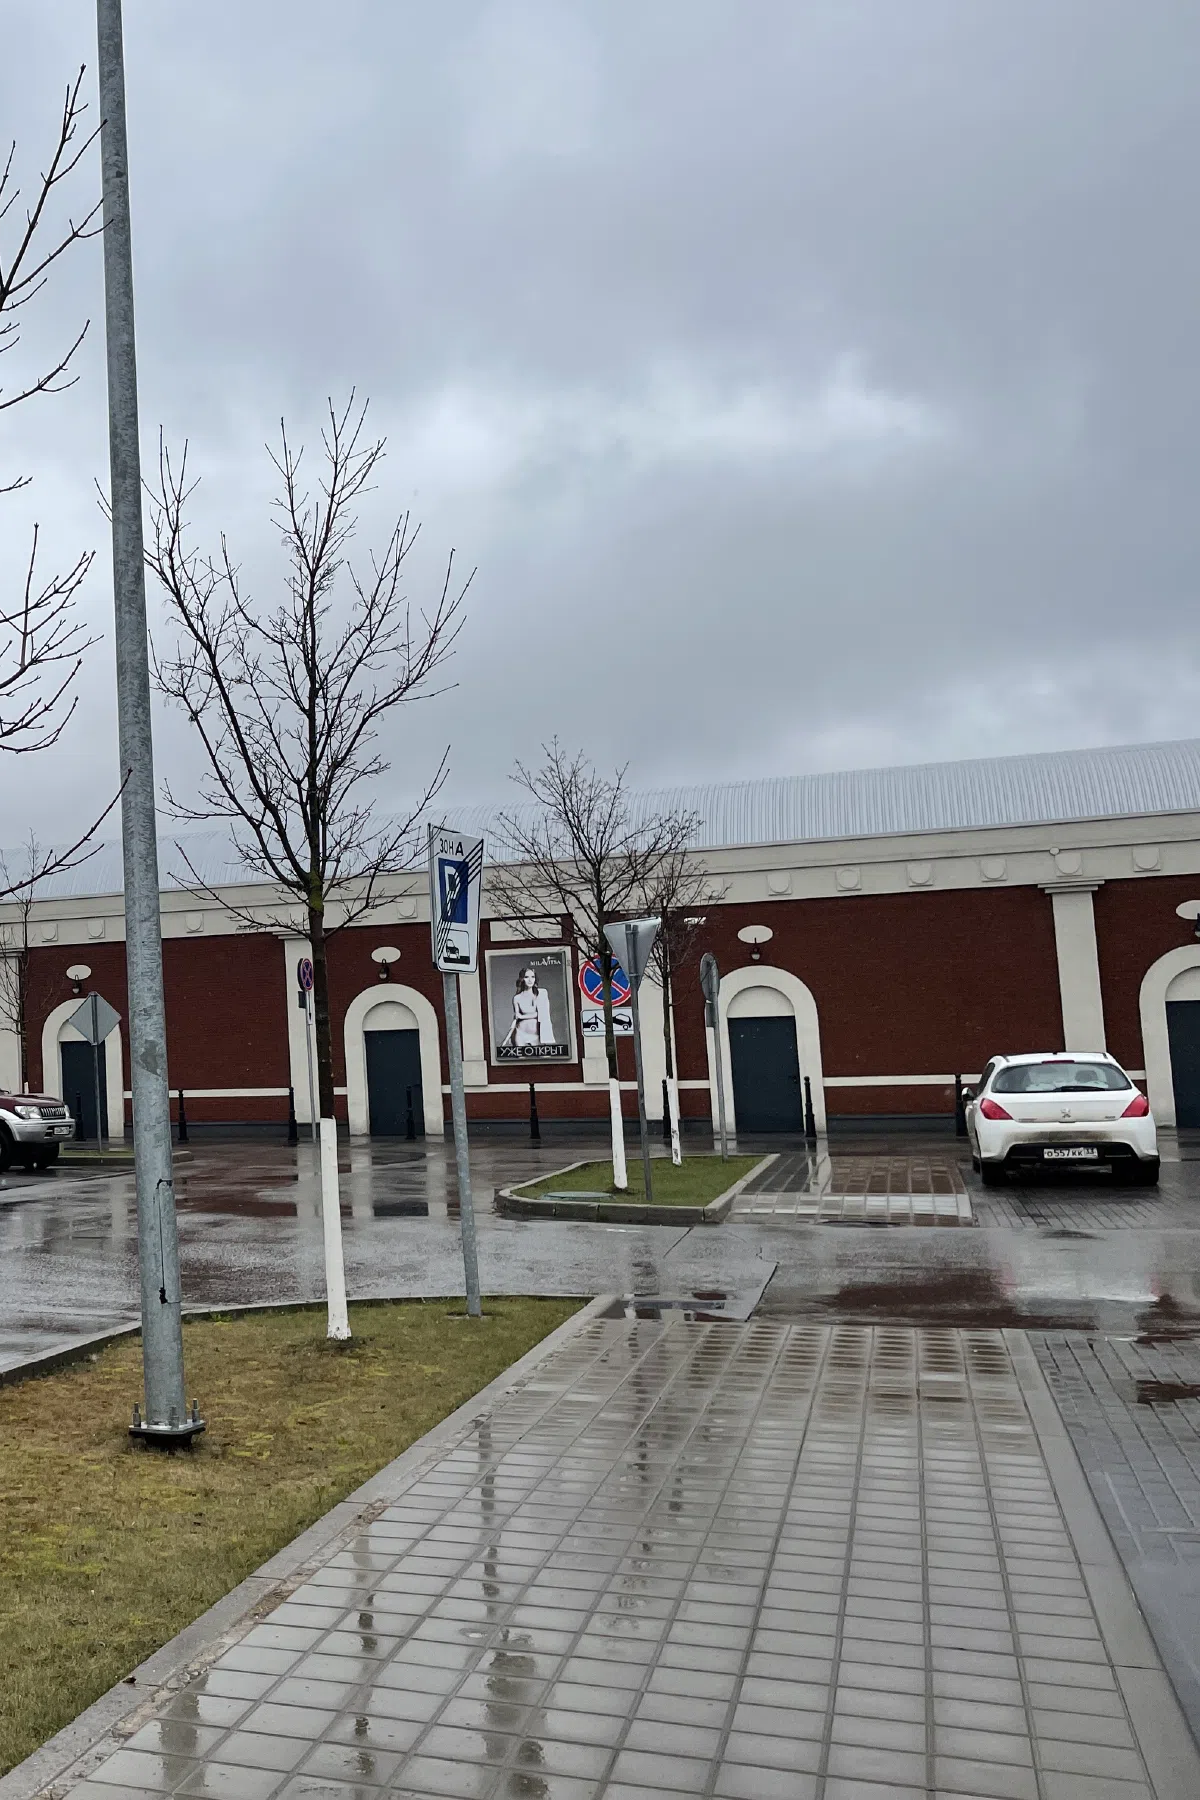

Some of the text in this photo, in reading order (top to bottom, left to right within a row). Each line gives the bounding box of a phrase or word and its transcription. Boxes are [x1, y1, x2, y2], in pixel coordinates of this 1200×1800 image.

[440, 838, 464, 857] ЗОНА
[500, 1045, 564, 1057] УЖЕ ОТКРЫТ
